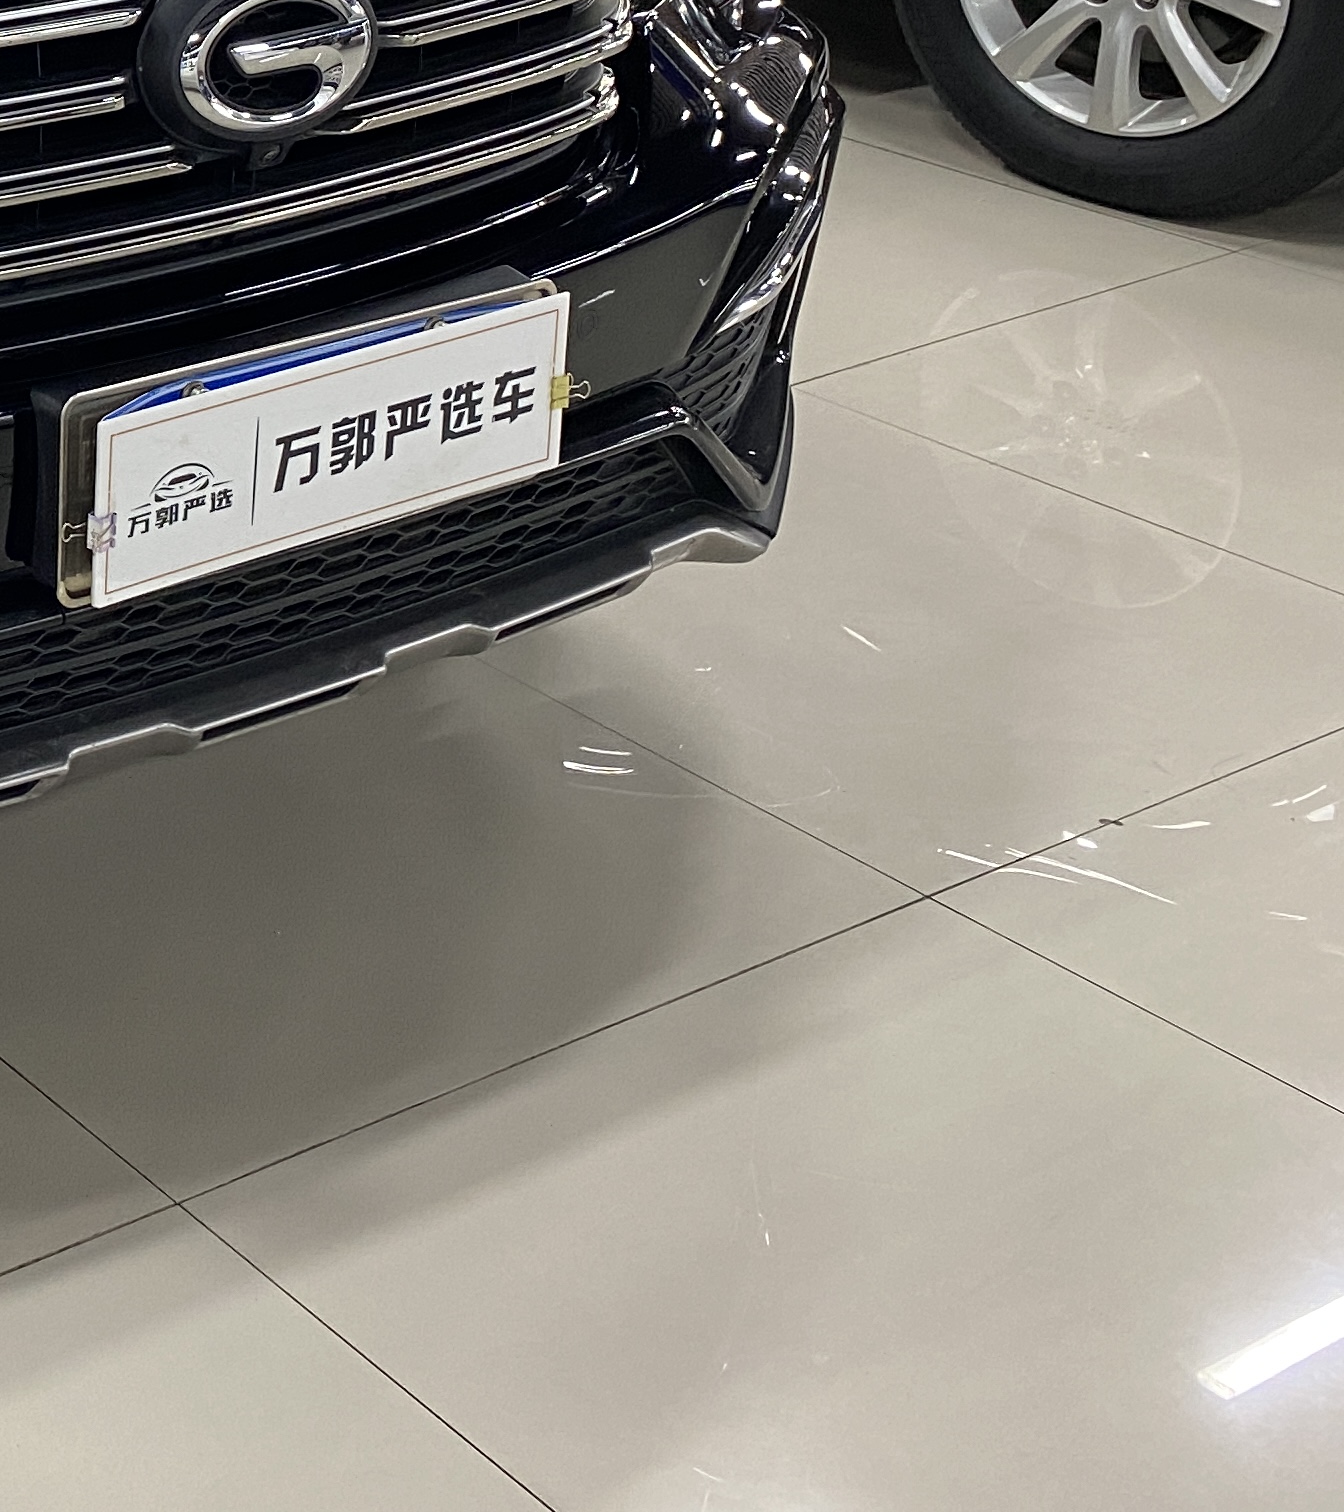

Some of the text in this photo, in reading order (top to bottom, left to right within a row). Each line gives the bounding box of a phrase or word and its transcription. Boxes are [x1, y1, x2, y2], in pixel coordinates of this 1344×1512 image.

[272, 365, 537, 494] 万郭严选车
[126, 488, 234, 539] 万郭严选
